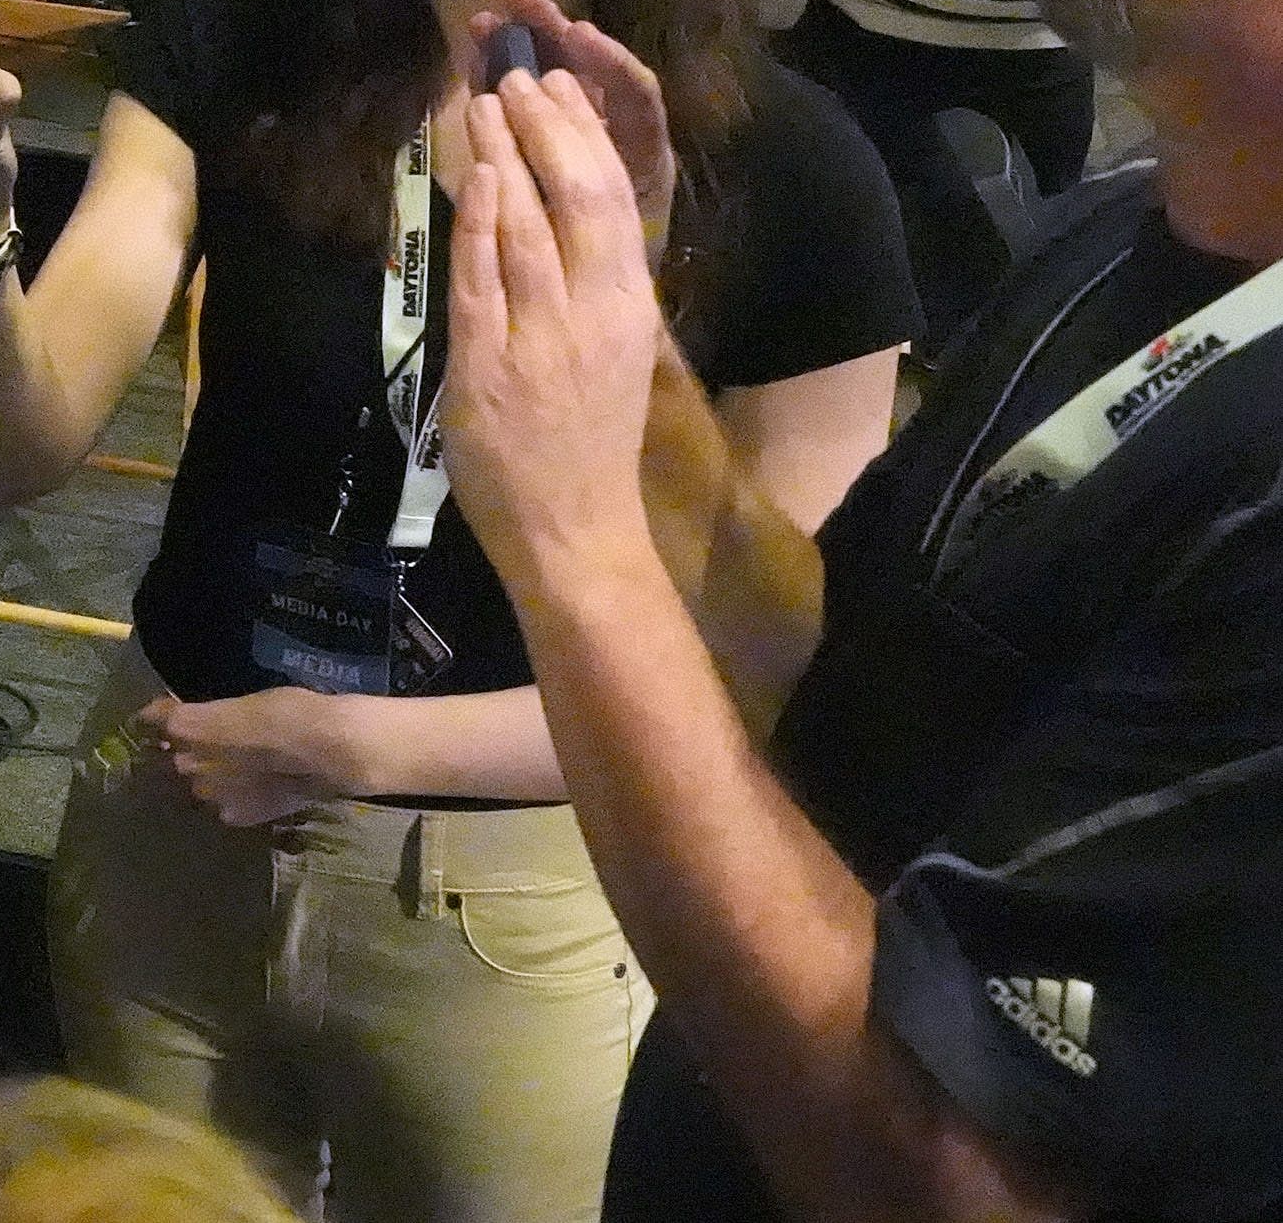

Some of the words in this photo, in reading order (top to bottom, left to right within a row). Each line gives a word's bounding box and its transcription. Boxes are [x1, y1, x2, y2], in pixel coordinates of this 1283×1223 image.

[402, 230, 419, 318] DAYTONA
[1104, 333, 1230, 430] DAYTONA
[271, 592, 328, 621] MEDIA
